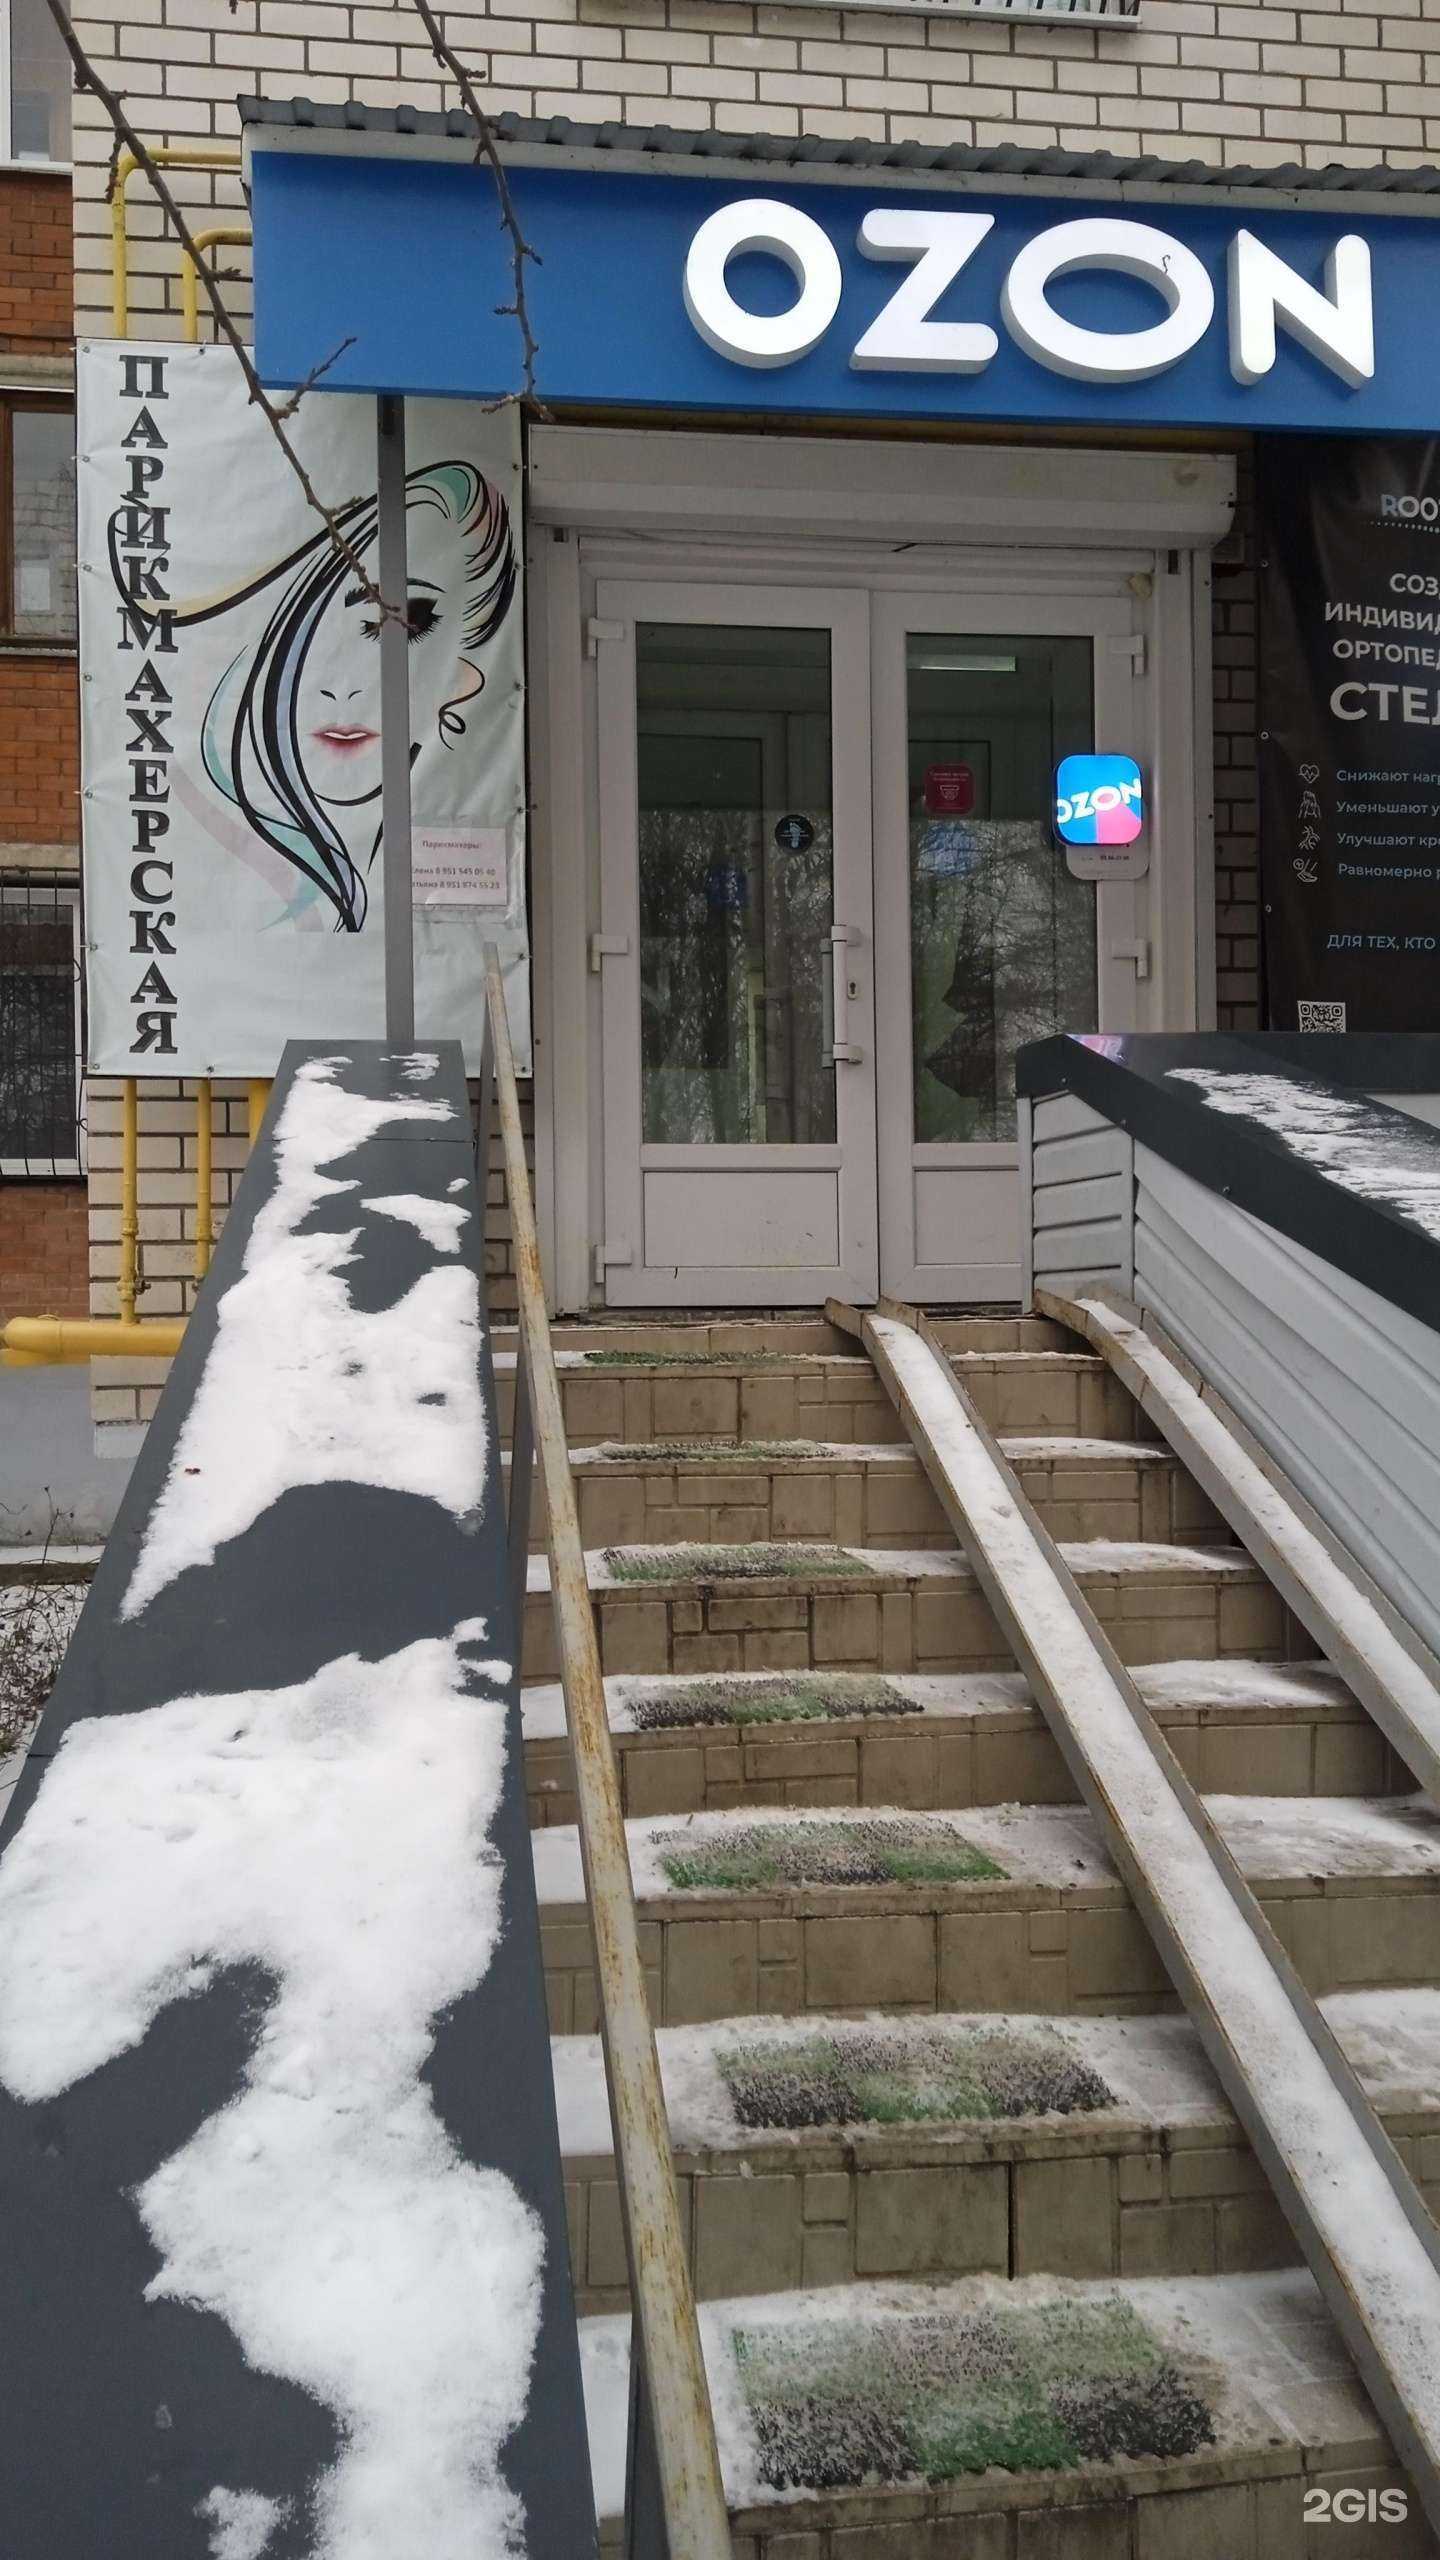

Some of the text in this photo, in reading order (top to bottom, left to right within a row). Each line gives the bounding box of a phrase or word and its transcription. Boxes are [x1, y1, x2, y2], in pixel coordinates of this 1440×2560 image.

[683, 198, 1375, 390] OZON
[1381, 494, 1440, 521] ROO
[1389, 573, 1440, 598] СОЗ
[1332, 639, 1440, 671] ОРТОПЕ
[116, 354, 178, 1055] ПАРИКМАХЕРСКАЯ
[1336, 769, 1409, 782] Снижают
[1336, 800, 1428, 814] Уменьшают
[1336, 832, 1440, 848] Улучшают кр
[1338, 862, 1432, 879] Равномерно
[1327, 934, 1436, 950] ДЛЯ ТЕХ, КТО
